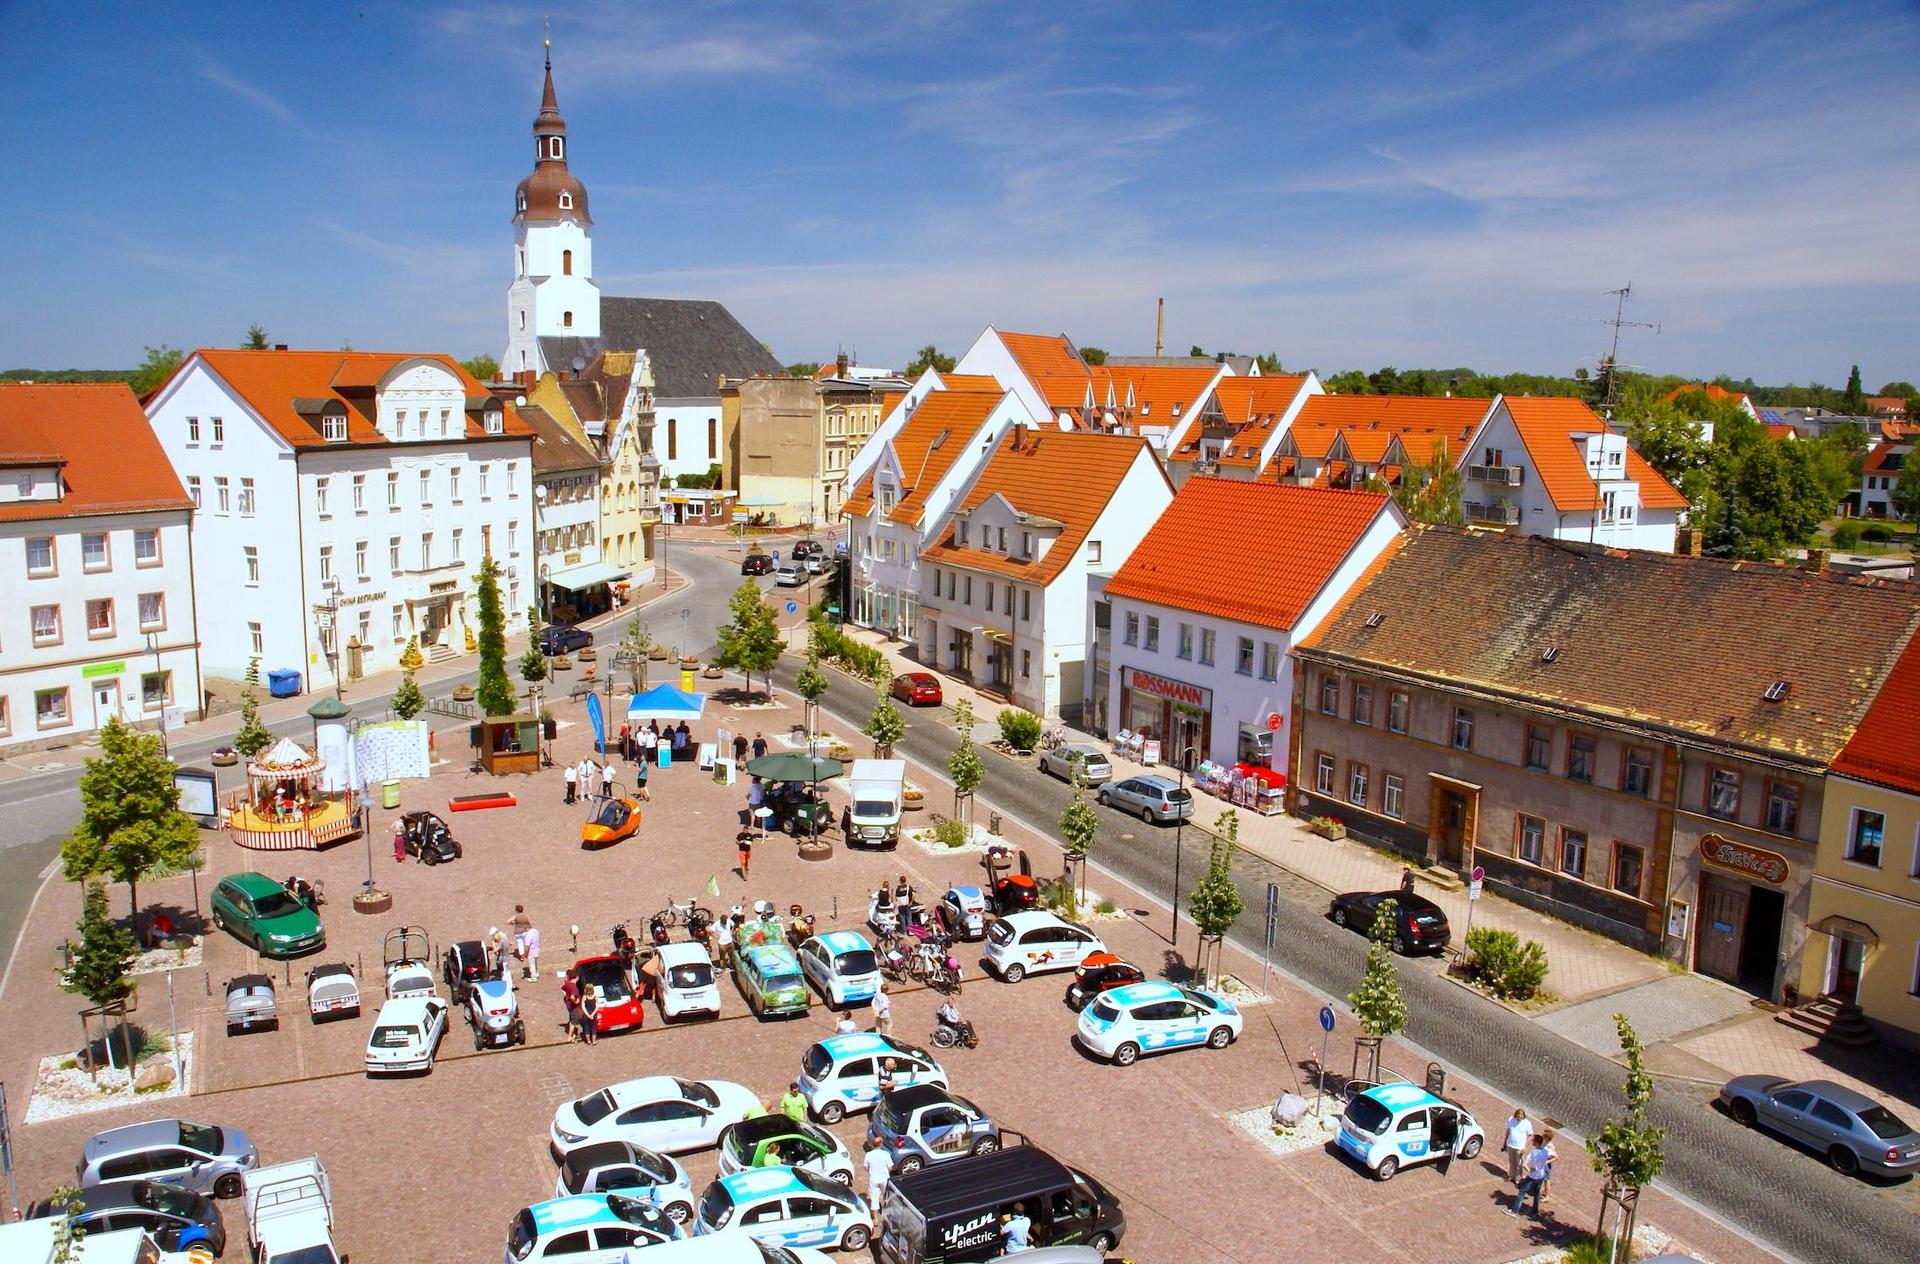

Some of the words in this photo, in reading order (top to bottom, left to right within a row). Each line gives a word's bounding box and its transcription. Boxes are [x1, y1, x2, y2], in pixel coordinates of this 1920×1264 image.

[357, 591, 386, 604] RESTAURANT
[1132, 671, 1203, 705] ROSSMANN
[957, 1230, 993, 1249] electric
